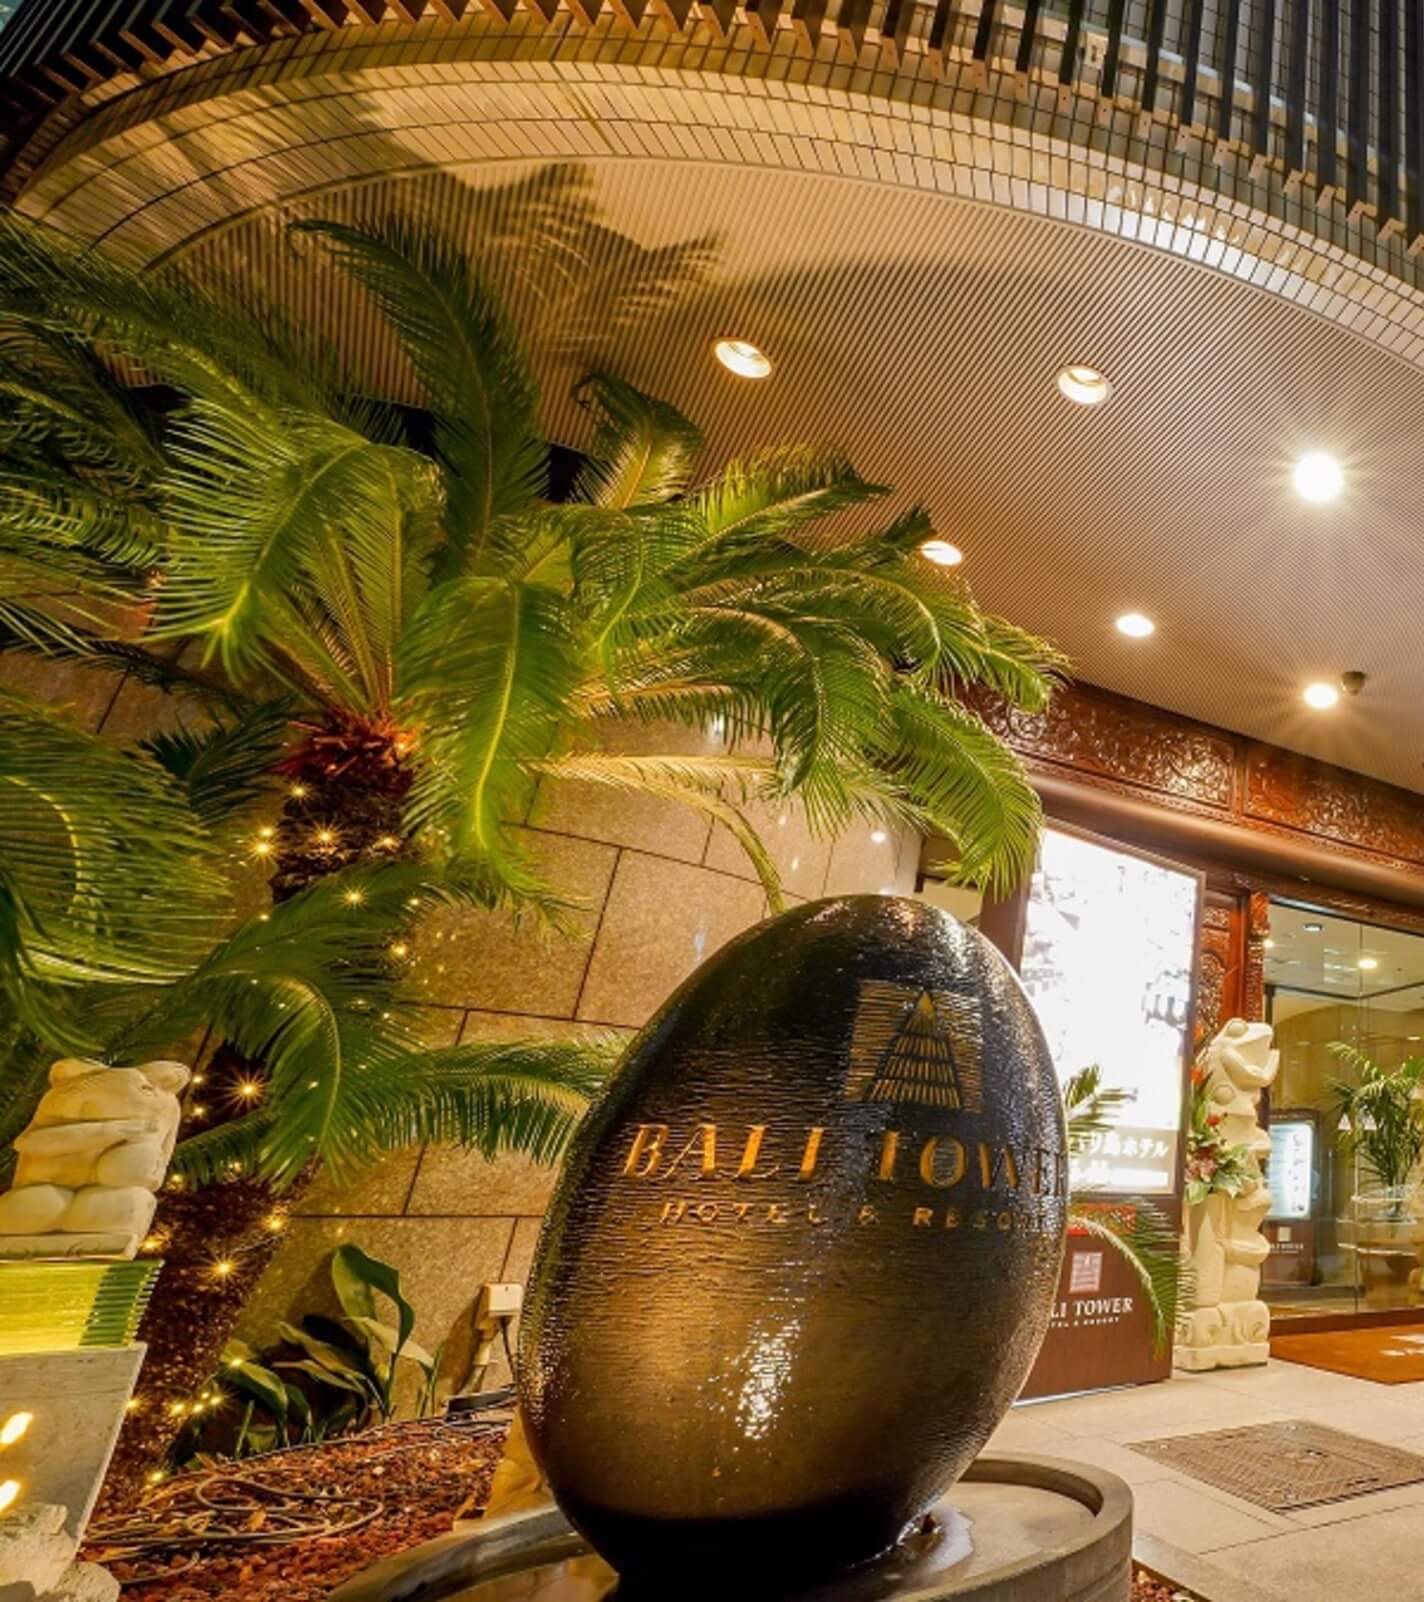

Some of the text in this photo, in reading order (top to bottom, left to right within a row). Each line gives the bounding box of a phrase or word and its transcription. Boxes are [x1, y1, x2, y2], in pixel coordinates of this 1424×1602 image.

[623, 1123, 825, 1182] BALI
[659, 1202, 828, 1224] HOTEL
[856, 1204, 880, 1225] &
[1050, 1297, 1133, 1318] LI TOWER
